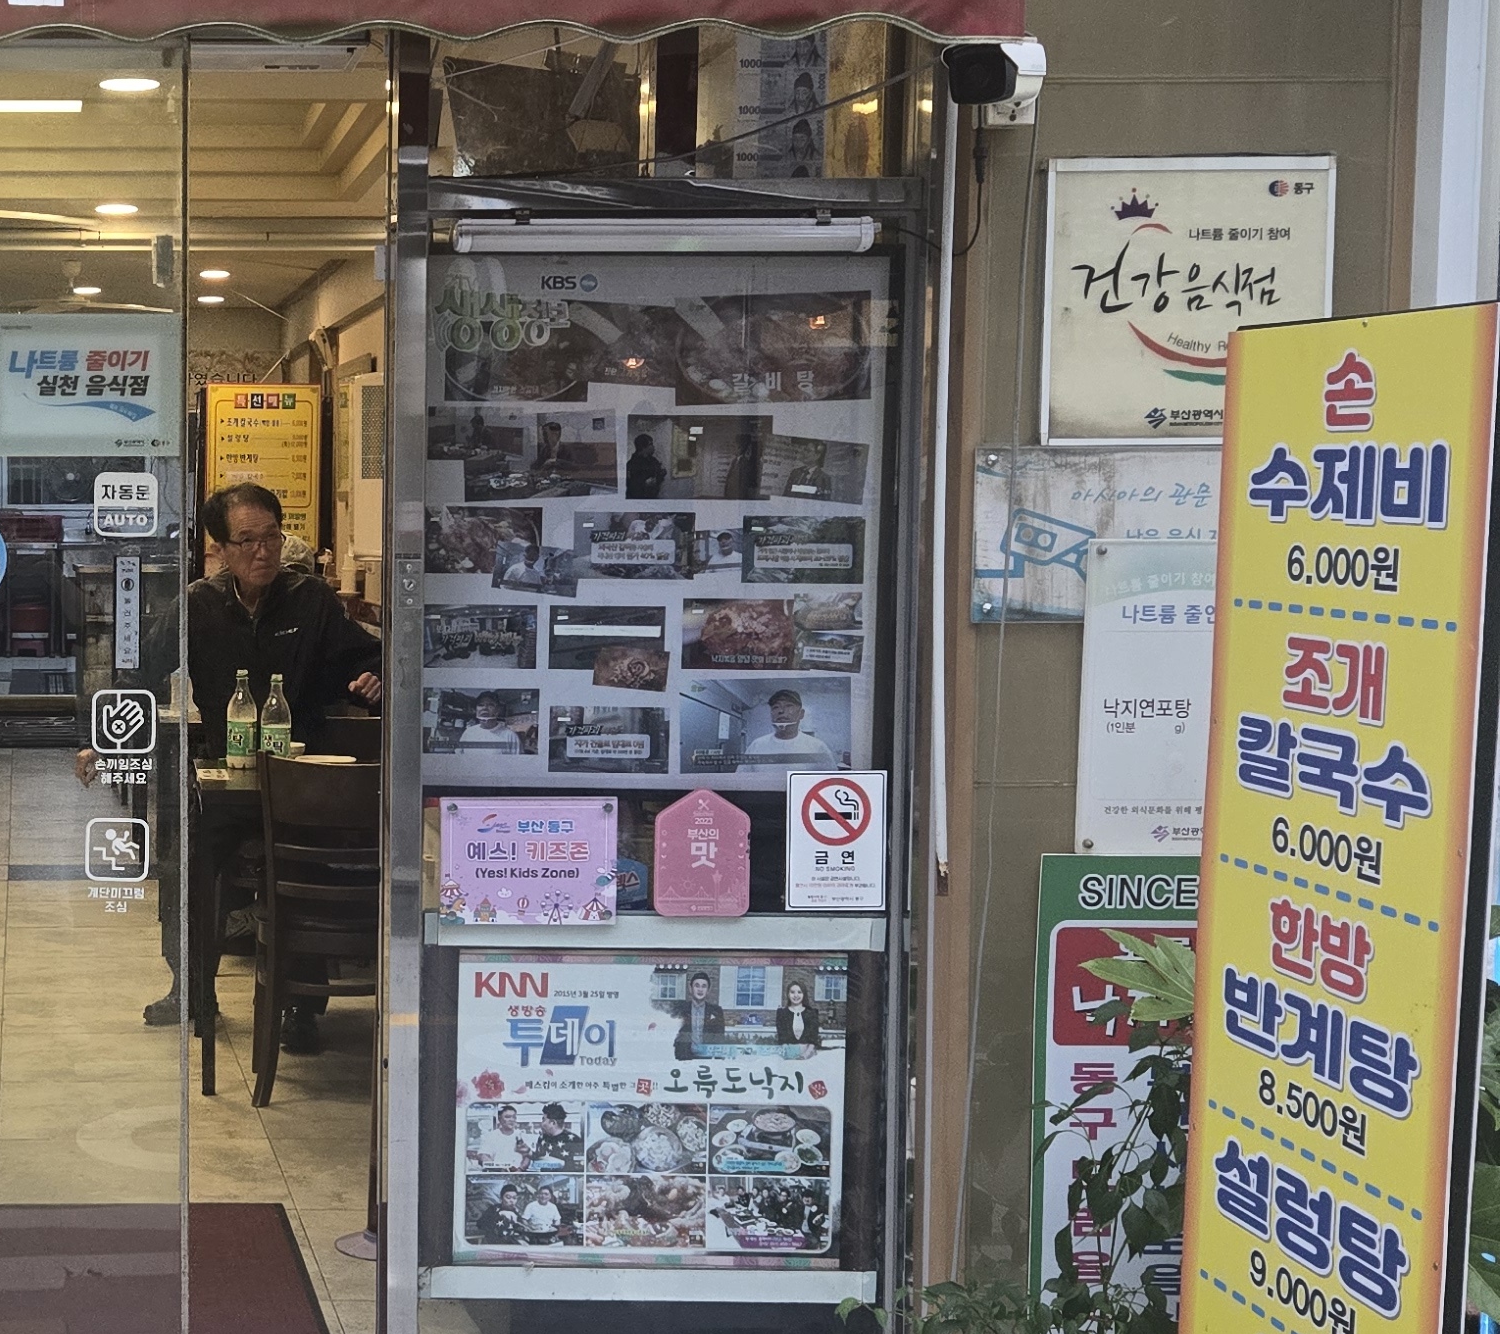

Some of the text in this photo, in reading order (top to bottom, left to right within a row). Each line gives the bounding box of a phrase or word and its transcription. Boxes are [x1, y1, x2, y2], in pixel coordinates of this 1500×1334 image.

[740, 59, 762, 68] 1000
[737, 153, 759, 162] 1000
[1294, 183, 1314, 195] 동구
[1189, 227, 1291, 241] 나트륨 줄이기 참여
[541, 276, 576, 290] KBS
[1071, 239, 1281, 316] 건강음식점
[1167, 333, 1211, 354] Healthy
[8, 350, 79, 378] 나트륨
[86, 350, 150, 371] 줄이기
[37, 375, 149, 396] 실천 음식점
[1323, 348, 1376, 431] 손
[1170, 409, 1223, 420] 부산광역시
[101, 485, 149, 500] 자동문
[1071, 482, 1213, 508] 아시아의 관문
[1248, 443, 1450, 528] 수제비
[104, 514, 148, 526] AUTO
[1287, 544, 1400, 592] 6.000원
[1122, 605, 1177, 624] 나트륨
[1283, 634, 1388, 726] 조개
[1104, 698, 1191, 718] 낙지연포탕
[95, 759, 153, 770] 손끼임조심
[1236, 714, 1432, 828] 칼국수
[101, 773, 147, 784] 해주세요
[518, 820, 574, 833] 부산 동구
[694, 817, 713, 825] 2023
[687, 829, 719, 840] 부산의
[467, 841, 590, 861] 예스! 키즈존
[691, 842, 718, 868] 맛
[1272, 816, 1382, 884] 6.000원
[475, 868, 579, 879] (Yes! Kids Zone)
[88, 887, 145, 899] 계단미끄럼
[1078, 873, 1199, 909] SINCE
[105, 901, 127, 913] 조심
[1269, 896, 1373, 1003] 한방
[475, 972, 548, 997] KNN
[554, 990, 577, 998] 2015년
[508, 1005, 546, 1017] 생방송
[503, 1018, 615, 1067] 투데이
[1223, 963, 1421, 1120] 반계탕
[580, 1056, 617, 1066] Today
[663, 1065, 804, 1099] 오륙도낙지
[1259, 1069, 1366, 1156] 8.500원
[1212, 1136, 1409, 1320] 설렁탕
